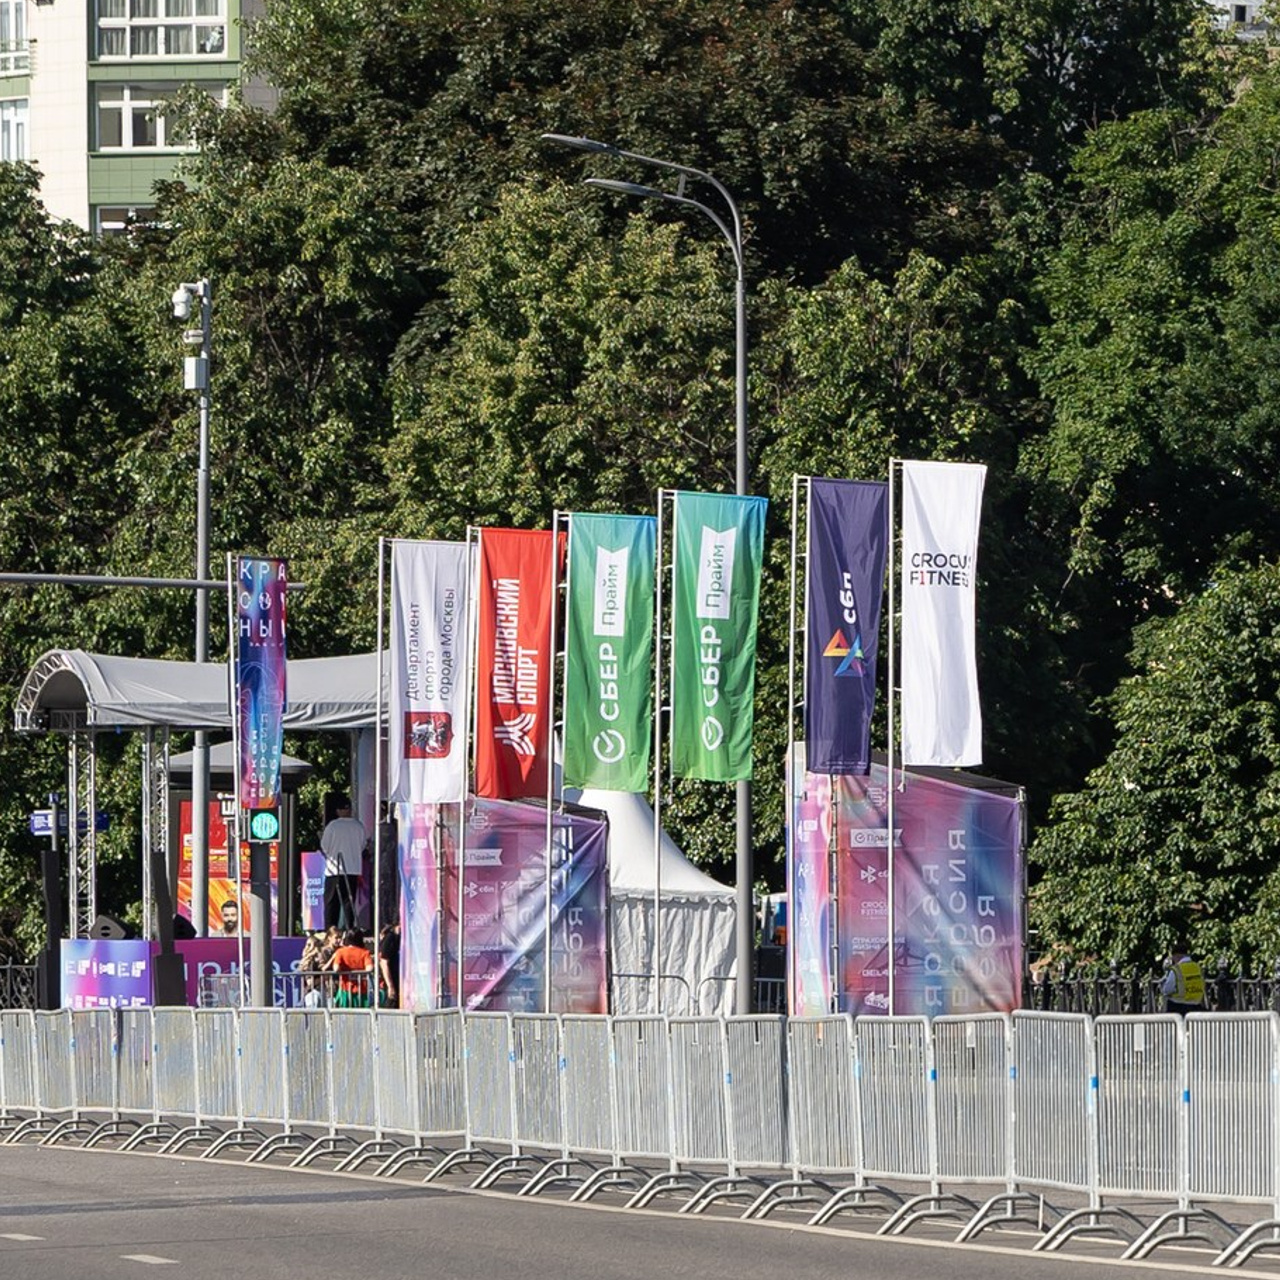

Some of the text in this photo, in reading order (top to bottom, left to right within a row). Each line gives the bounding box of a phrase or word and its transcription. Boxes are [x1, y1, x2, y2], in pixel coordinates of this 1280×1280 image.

[405, 602, 420, 702] Департамент
[439, 588, 455, 701] города Москвы
[493, 578, 520, 704] МОСКОВСКИЙ
[599, 564, 620, 721] СБЕР Прайм
[701, 544, 725, 708] СБЕР Прайм
[839, 572, 857, 624] сбп
[425, 650, 436, 701] спорта
[517, 646, 538, 705] СПОРТ
[922, 864, 943, 1007] яркая
[949, 829, 970, 1007] версия
